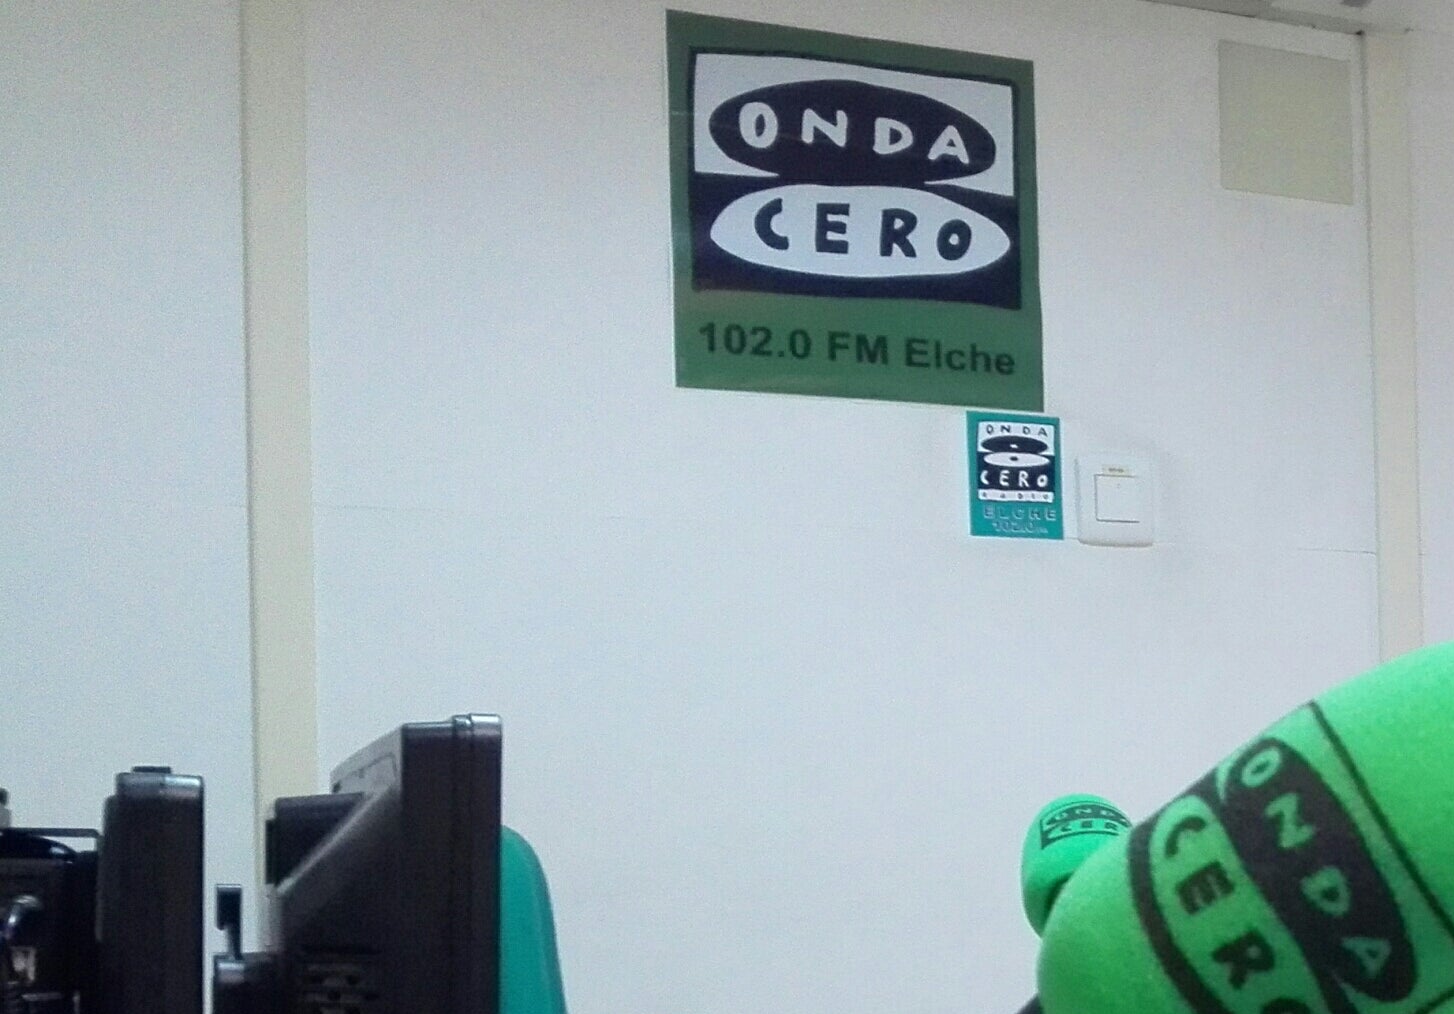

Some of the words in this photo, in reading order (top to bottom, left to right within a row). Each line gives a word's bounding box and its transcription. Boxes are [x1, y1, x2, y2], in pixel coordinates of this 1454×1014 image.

[738, 101, 971, 165] ONDA
[753, 197, 973, 262] CERO
[699, 321, 812, 360] 102.0
[827, 330, 889, 366] FM
[904, 337, 1015, 376] Elche
[985, 424, 1049, 437] ONDA
[980, 469, 1049, 488] CERO
[1241, 746, 1392, 979] ONDA
